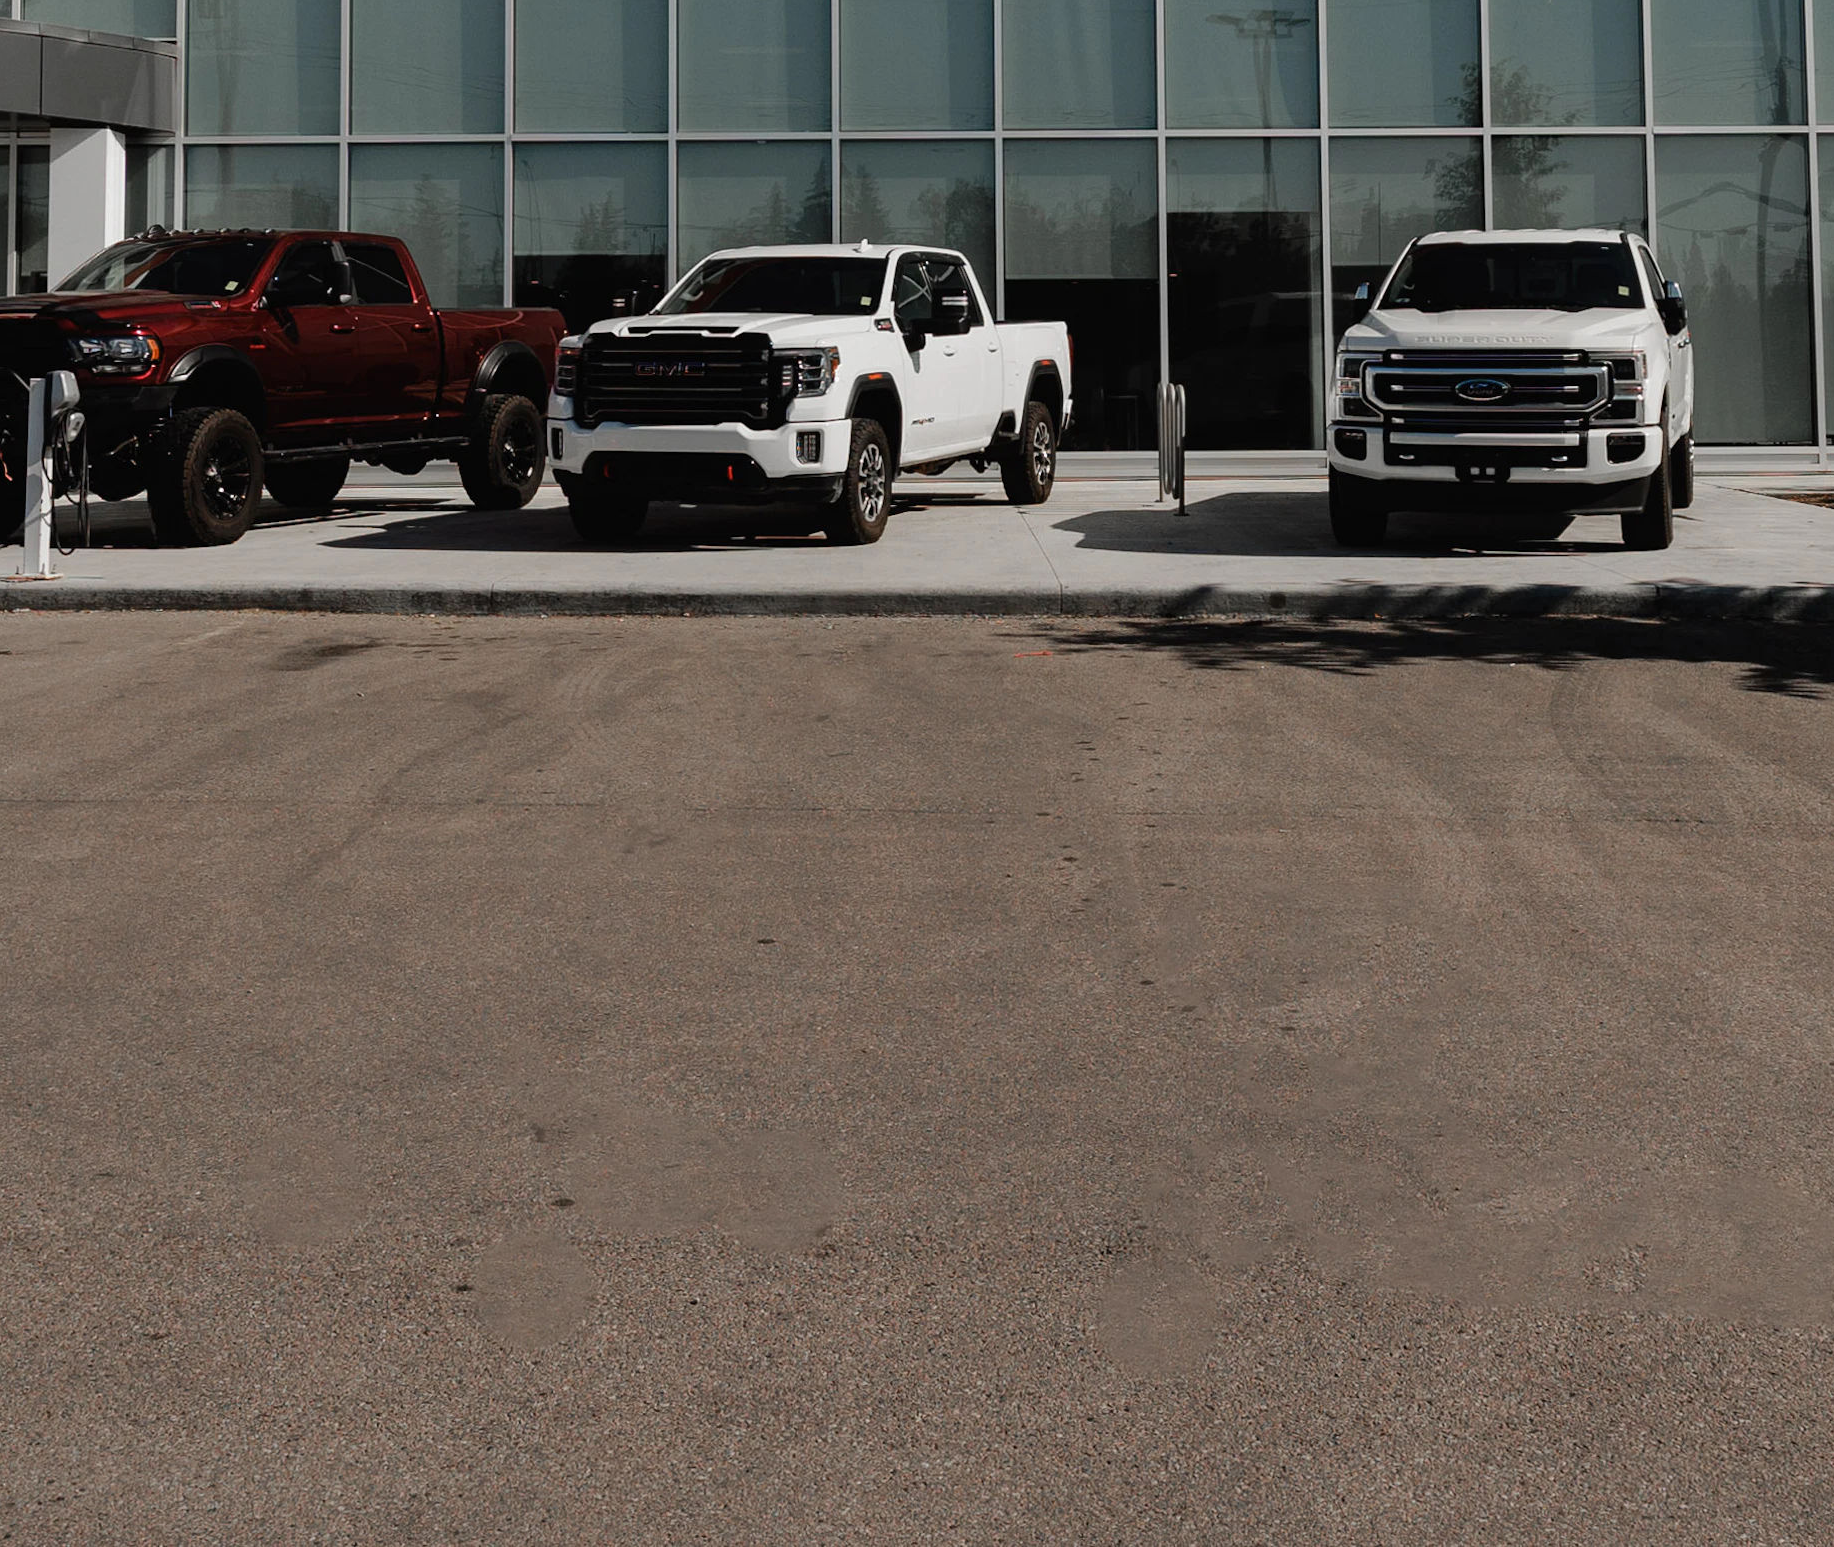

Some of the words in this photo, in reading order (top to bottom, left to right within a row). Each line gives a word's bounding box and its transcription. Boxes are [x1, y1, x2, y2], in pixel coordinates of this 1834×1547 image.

[1415, 335, 1489, 344] SUPER
[1493, 335, 1554, 344] DUTY
[635, 361, 705, 376] GMC
